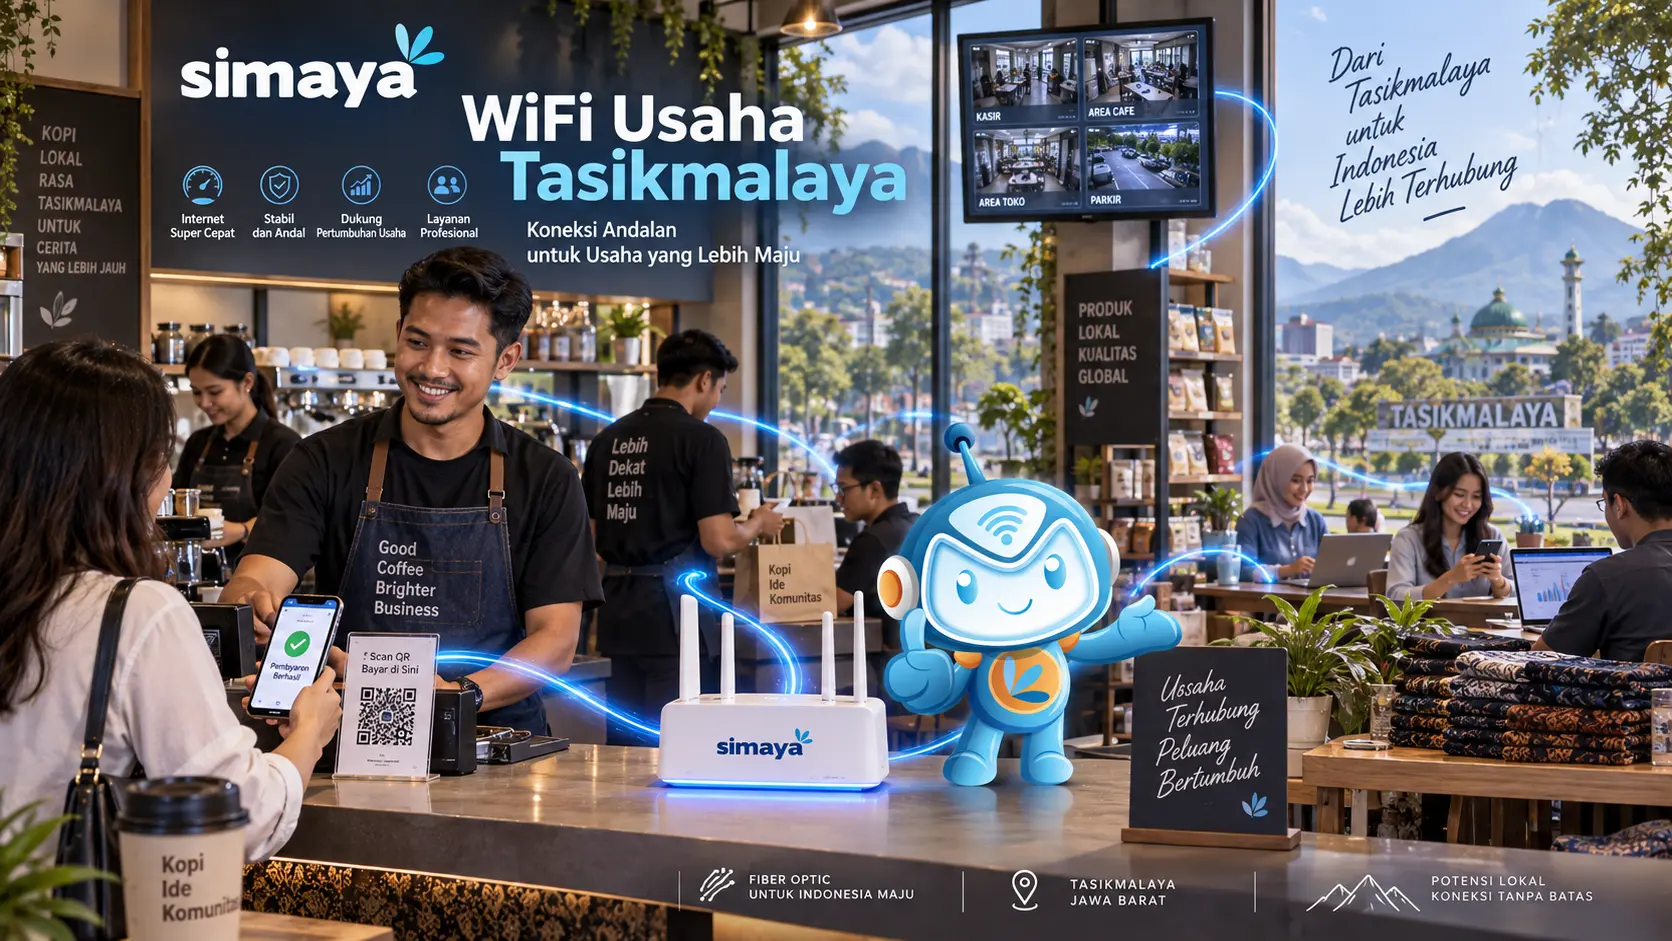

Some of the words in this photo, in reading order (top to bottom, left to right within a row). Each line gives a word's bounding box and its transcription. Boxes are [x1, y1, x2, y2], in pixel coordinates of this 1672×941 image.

[976, 111, 1001, 122] KASIR
[1088, 107, 1111, 118] AREA
[1112, 106, 1135, 117] CAFE
[41, 125, 76, 142] KOPI
[40, 150, 83, 166] LOKAL
[39, 173, 74, 188] RASA
[38, 196, 122, 212] TASIKMALAYA
[978, 197, 1001, 208] AREA
[1002, 196, 1026, 207] TOKO
[1090, 195, 1122, 205] PARKIR
[37, 219, 81, 234] UNTUK
[36, 241, 77, 255] CERITA
[36, 261, 65, 274] YANG
[68, 261, 97, 274] LEBIH
[100, 262, 126, 274] JAUH
[1078, 300, 1133, 318] PRODUK
[1078, 324, 1120, 340] LOKAL
[1078, 346, 1137, 362] KUALITAS
[1078, 369, 1129, 385] GLOBAL
[1390, 402, 1558, 428] TASIKMALAYA
[612, 437, 648, 455] Lebih
[609, 459, 646, 476] Dekat
[607, 482, 642, 498] Lebih
[607, 503, 637, 524] Maju
[378, 540, 417, 557] Good
[377, 560, 424, 576] Coffee
[768, 563, 791, 577] Kopi
[375, 580, 436, 599] Brighter
[769, 579, 785, 591] Ide
[769, 593, 822, 605] Komunitas
[374, 601, 439, 617] Business
[370, 652, 393, 661] Scan
[395, 652, 411, 662] QR
[361, 664, 388, 675] Bayar
[390, 664, 399, 674] di
[401, 664, 419, 674] Sini
[1166, 696, 1260, 733] Terhubung
[716, 737, 804, 760] simaya
[1155, 734, 1231, 766] Peluang
[1157, 753, 1260, 799] Bertumbuh
[162, 853, 204, 876] Kopi
[162, 880, 192, 898] Ide
